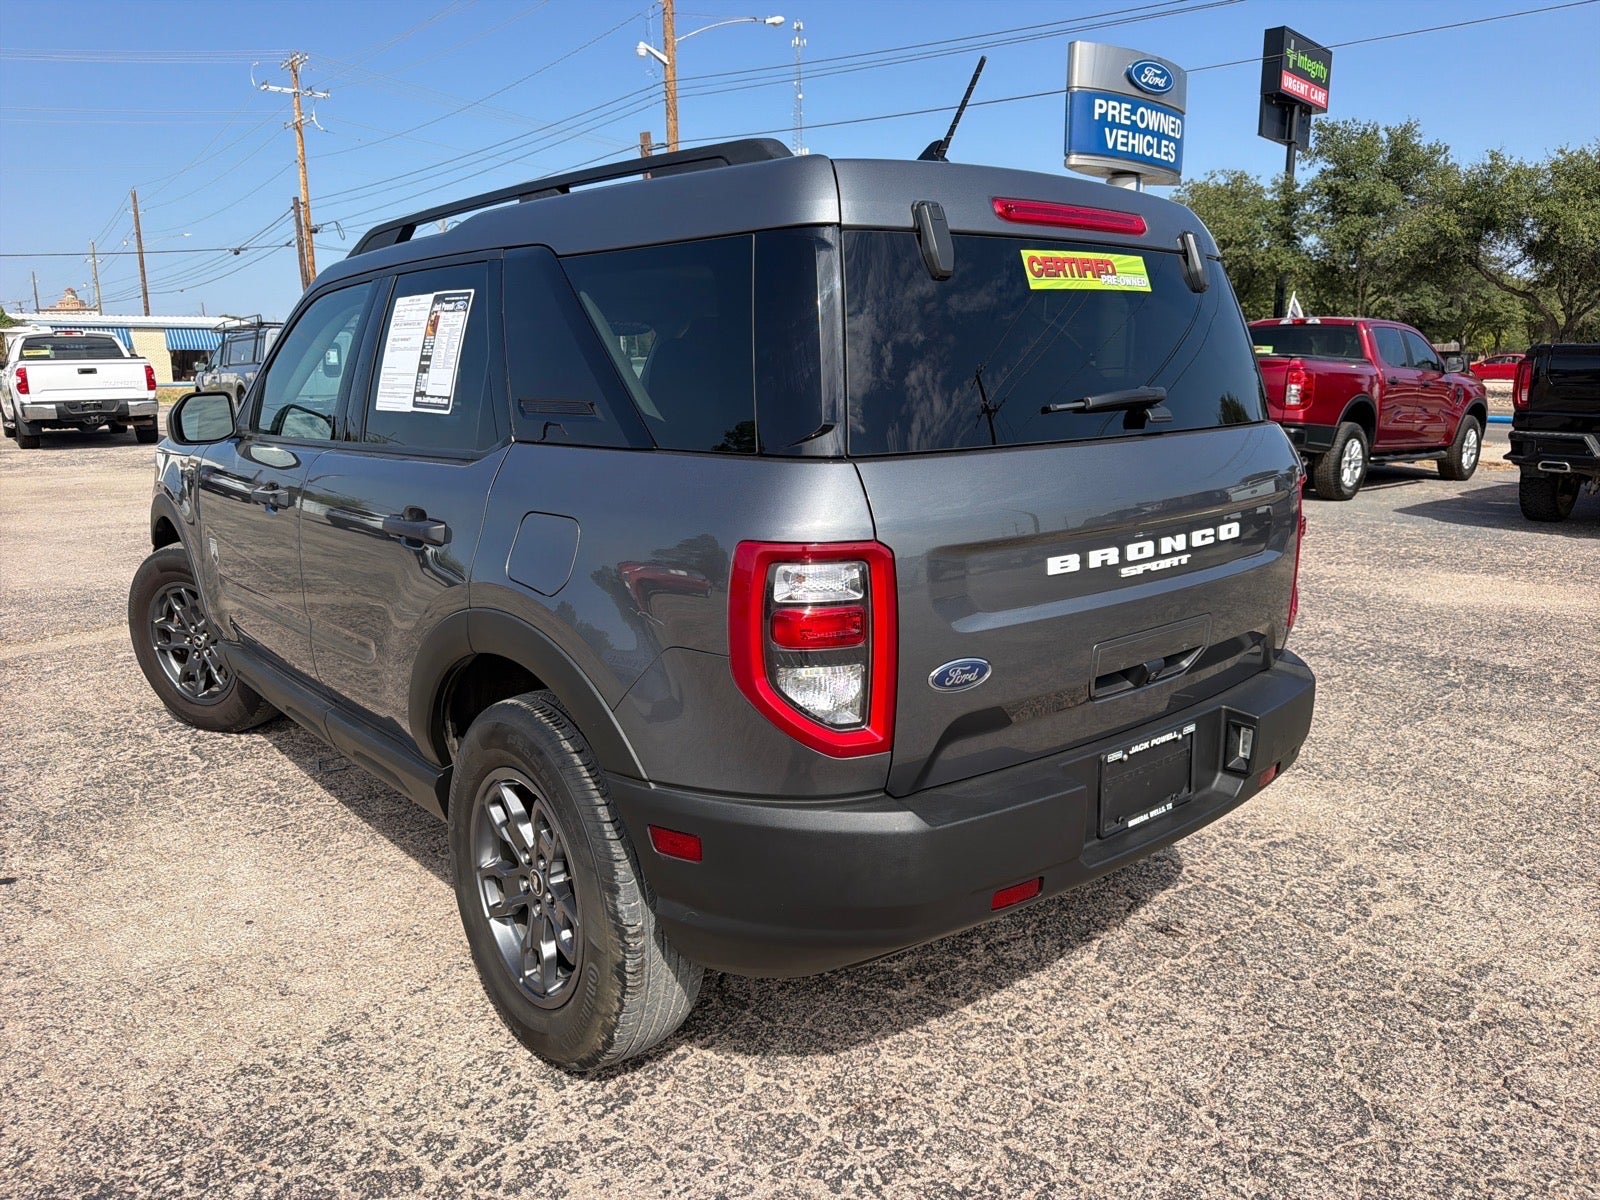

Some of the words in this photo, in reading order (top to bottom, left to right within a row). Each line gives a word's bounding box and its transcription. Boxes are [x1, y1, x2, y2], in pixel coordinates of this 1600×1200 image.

[1140, 66, 1168, 88] Ford
[1283, 75, 1308, 97] URGENT
[1310, 87, 1327, 105] CARE
[1093, 98, 1182, 140] PRE-OWNED
[1104, 127, 1176, 164] VEHICLES
[1027, 255, 1117, 279] CERTIFIED
[1100, 274, 1147, 288] PRE-OWNED
[1046, 521, 1241, 577] BRONCO
[1119, 553, 1192, 579] SPORT
[944, 665, 980, 687] Ford
[1128, 741, 1150, 755] JACK
[1150, 731, 1179, 748] POWELL
